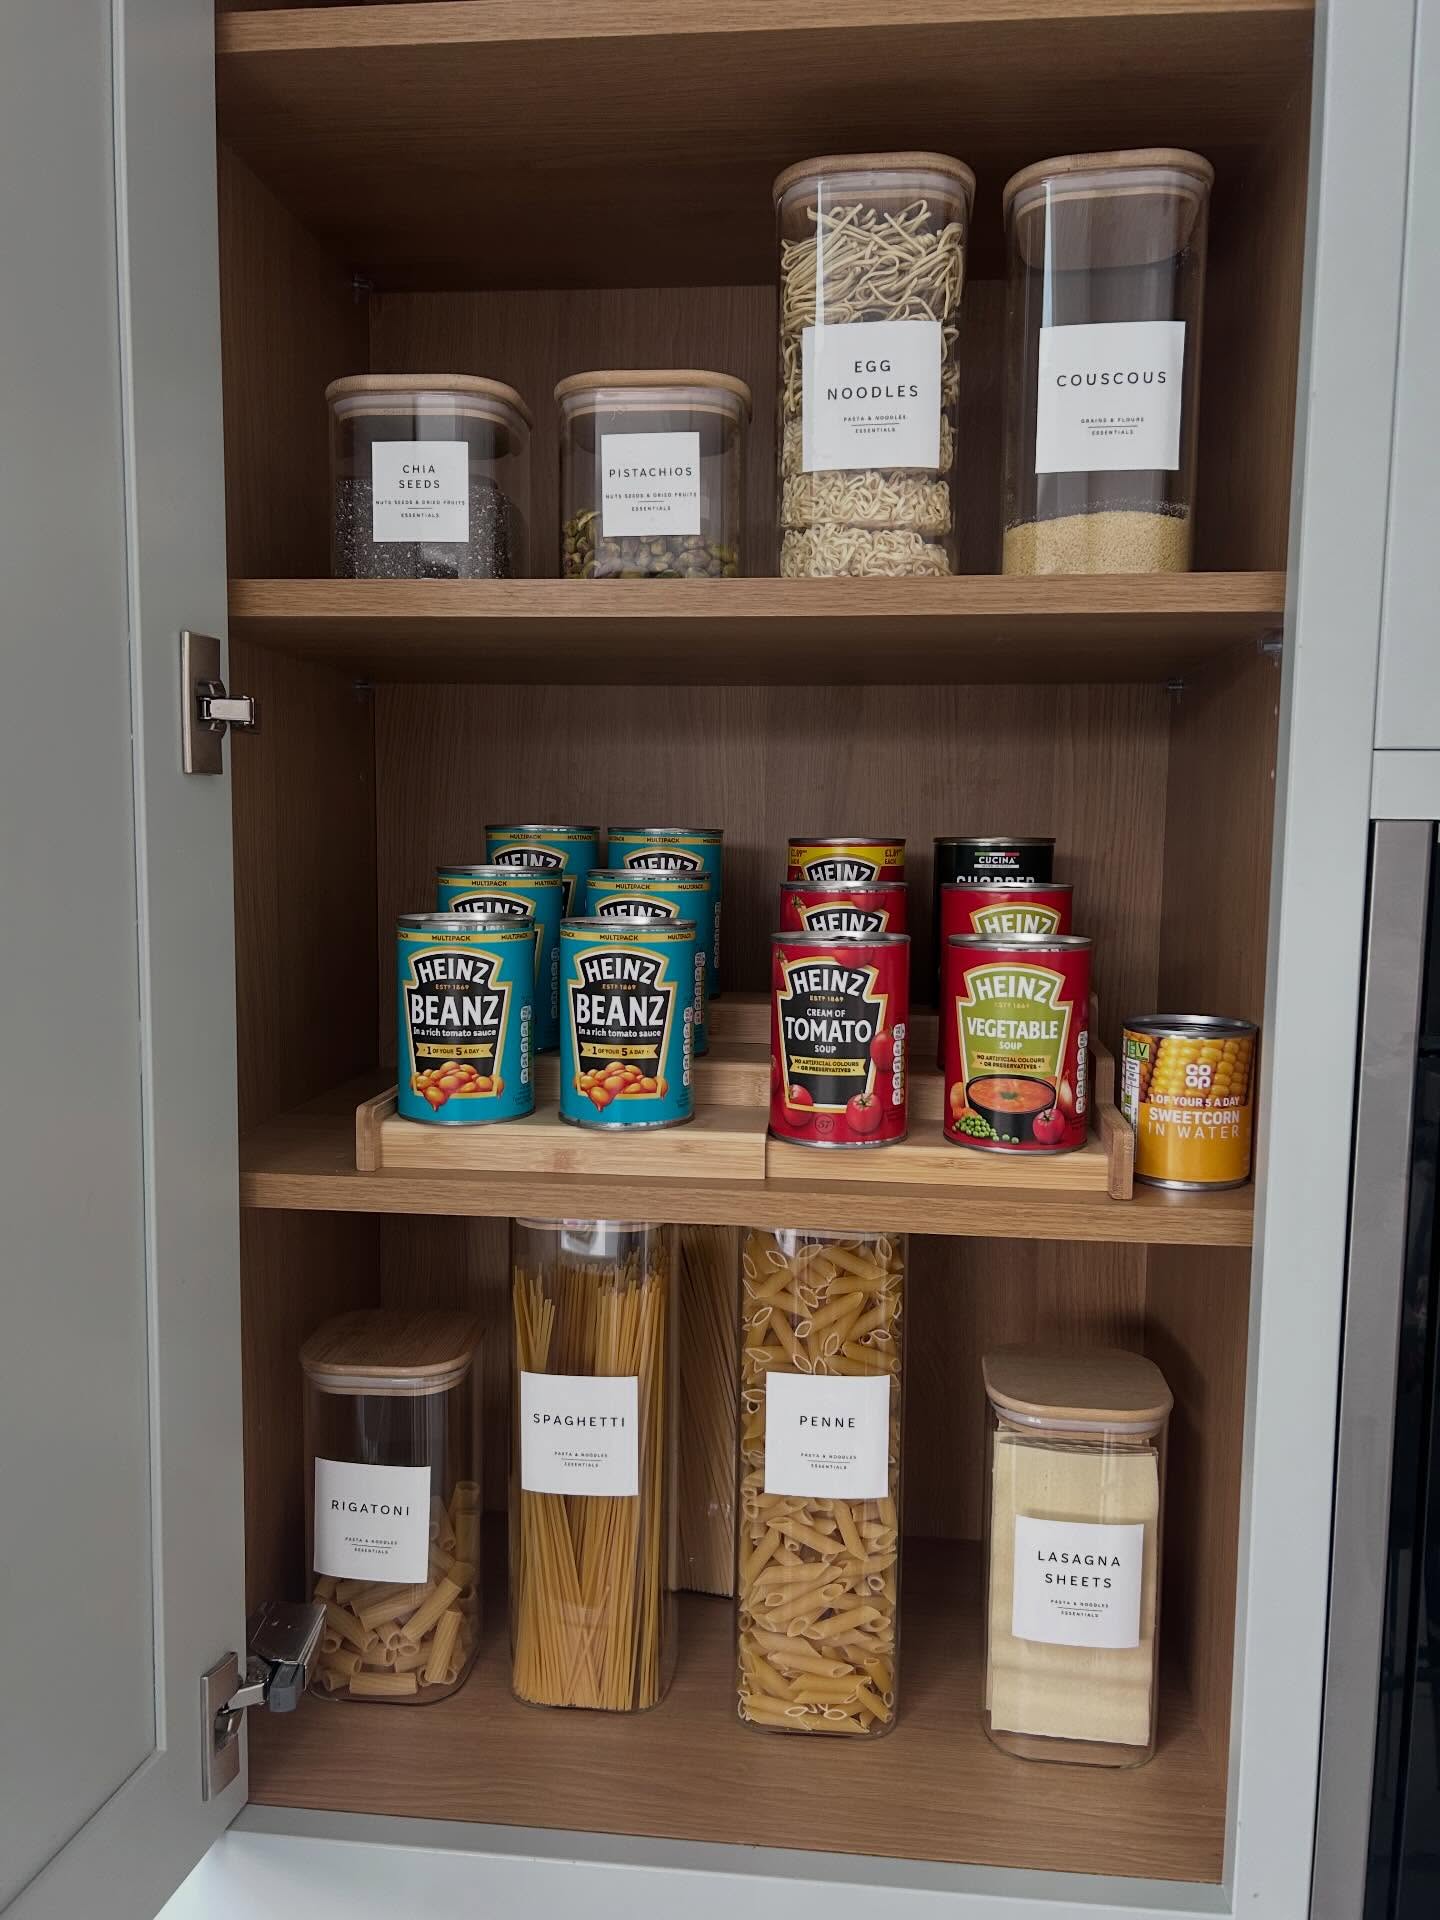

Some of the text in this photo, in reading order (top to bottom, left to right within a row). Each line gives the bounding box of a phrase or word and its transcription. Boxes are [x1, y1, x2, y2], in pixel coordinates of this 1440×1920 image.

[854, 360, 891, 373] EGG
[1056, 371, 1167, 387] COUSCOUS
[827, 385, 919, 401] NOODLES
[402, 464, 435, 474] CHIA
[609, 467, 692, 479] PISTACHIOS
[398, 479, 440, 489] SEEDS
[509, 833, 542, 841] MULTIPACK
[978, 856, 1015, 864] CUCINA
[811, 863, 871, 881] HEINZ
[811, 912, 879, 932] HEINZ
[983, 913, 1052, 934] HEINZ
[418, 957, 490, 985] HEINZ
[584, 957, 656, 985] HEINZ
[792, 969, 865, 997] HEINZ
[975, 975, 1052, 1004] HEINZ
[411, 994, 499, 1027] BEANZ
[576, 994, 665, 1027] BEANZ
[806, 1008, 846, 1018] CREAM OF
[413, 1027, 421, 1035] In
[426, 1028, 441, 1037] rich
[441, 1028, 472, 1037] tomato
[473, 1029, 497, 1037] sauce
[578, 1026, 586, 1035] In
[592, 1027, 606, 1037] rich
[608, 1029, 638, 1037] tomato
[785, 1017, 872, 1043] TOMATO
[967, 1016, 1059, 1040] VEGETABLE
[427, 1046, 432, 1055] 1
[456, 1046, 462, 1056] 5
[592, 1046, 597, 1055] 1
[621, 1047, 628, 1056] 5
[814, 1044, 837, 1054] SOUP
[998, 1041, 1023, 1050] SOUP
[802, 1059, 832, 1067] ARTIFICIAL
[985, 1055, 1017, 1063] ARTIFICIAL
[1150, 1093, 1240, 1107] 1 OF YOUR 5 A DAY
[1149, 1107, 1240, 1125] SWEETCORN
[1148, 1122, 1240, 1139] IN WATER
[533, 1413, 625, 1428] SPAGHETTI
[799, 1415, 856, 1428] PENNE
[331, 1499, 409, 1516] RIGATONI
[1038, 1550, 1121, 1567] LASAGNA
[1044, 1573, 1112, 1588] SHEETS
